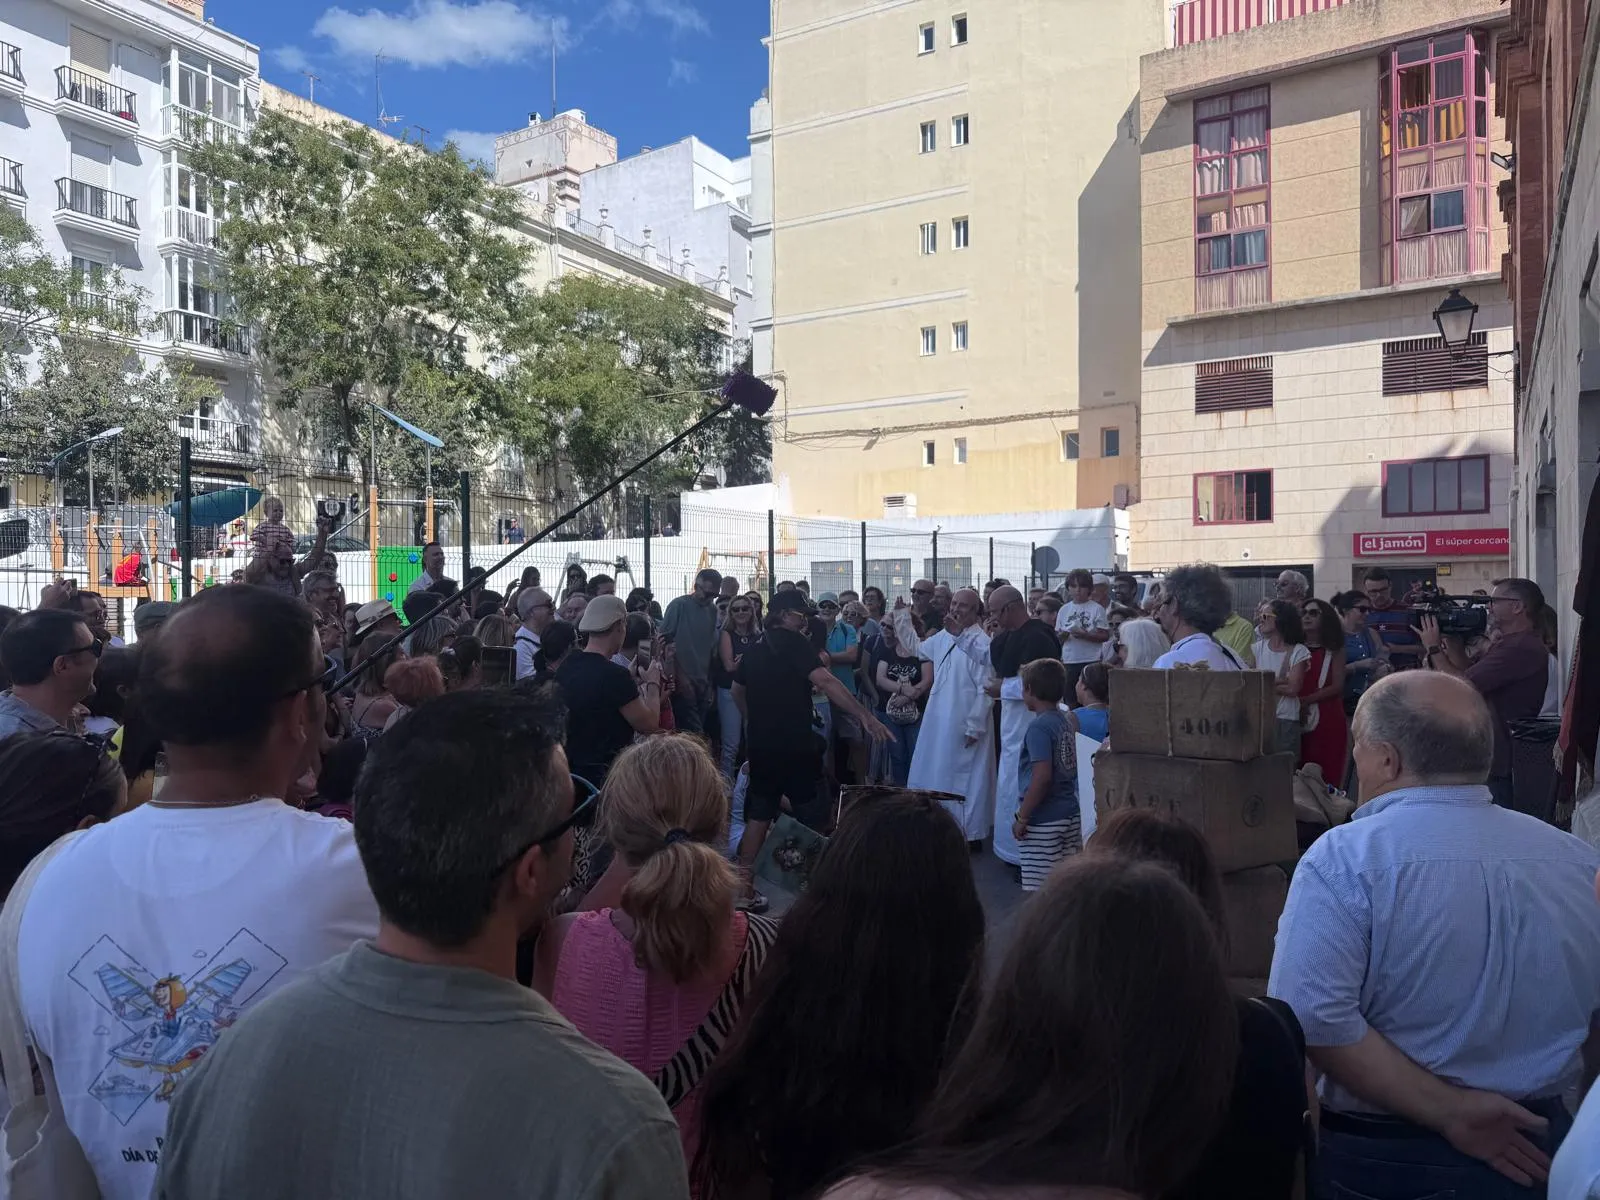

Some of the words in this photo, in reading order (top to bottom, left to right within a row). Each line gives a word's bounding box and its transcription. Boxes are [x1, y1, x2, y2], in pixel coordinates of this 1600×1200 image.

[1364, 537, 1376, 549] el
[1379, 535, 1423, 550] jamón
[1435, 538, 1445, 546] El
[1446, 537, 1473, 547] súper
[121, 1146, 146, 1162] DÍA
